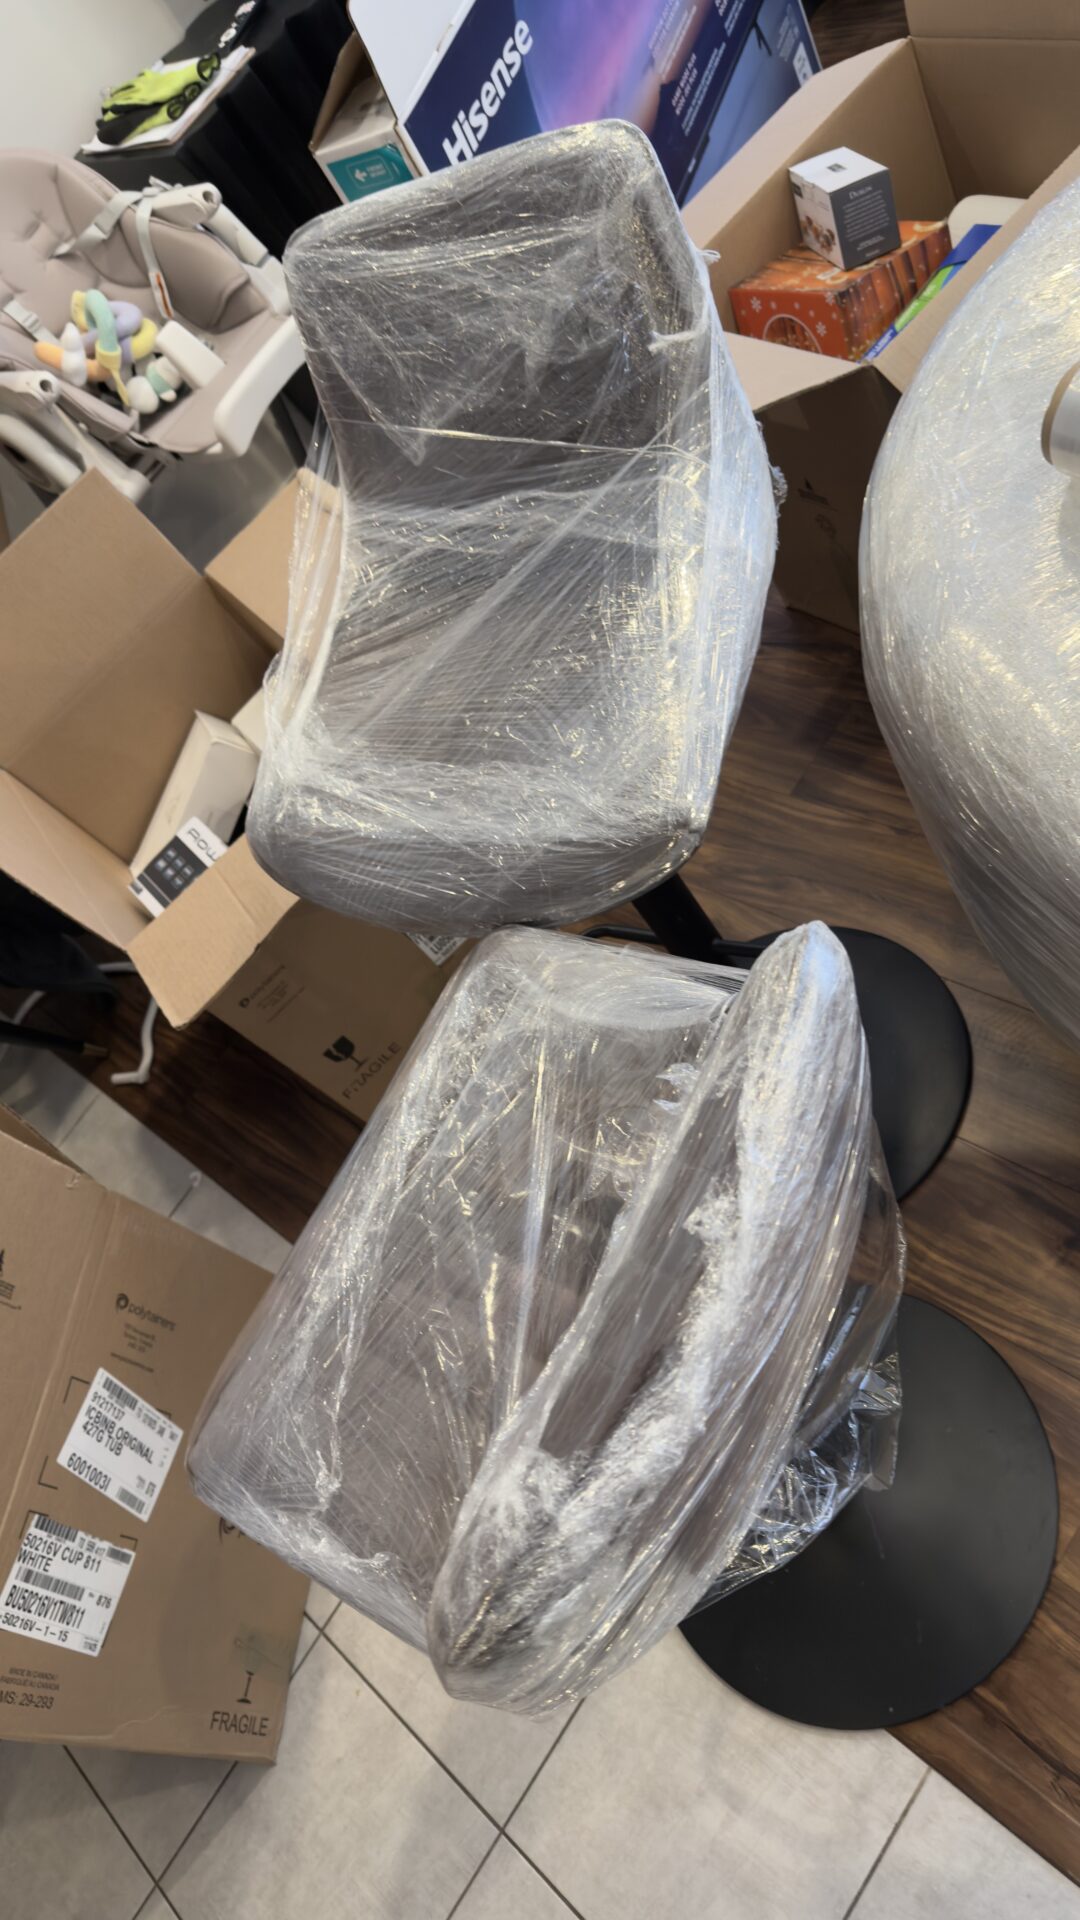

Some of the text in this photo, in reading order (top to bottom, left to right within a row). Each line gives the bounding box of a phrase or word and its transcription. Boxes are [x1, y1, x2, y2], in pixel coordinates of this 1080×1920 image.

[442, 19, 533, 167] Hisense
[342, 1041, 401, 1100] FRAGILE
[90, 1391, 125, 1423] 91217137
[82, 1420, 124, 1456] 427G TUB
[84, 1405, 117, 1435] ICBINB
[115, 1427, 155, 1464] ORIGINAL
[17, 1547, 54, 1572] WHITE
[23, 1533, 62, 1558] 50216V
[60, 1546, 84, 1566] CUP
[83, 1557, 102, 1573] 811
[209, 1710, 269, 1737] FRAGILE
